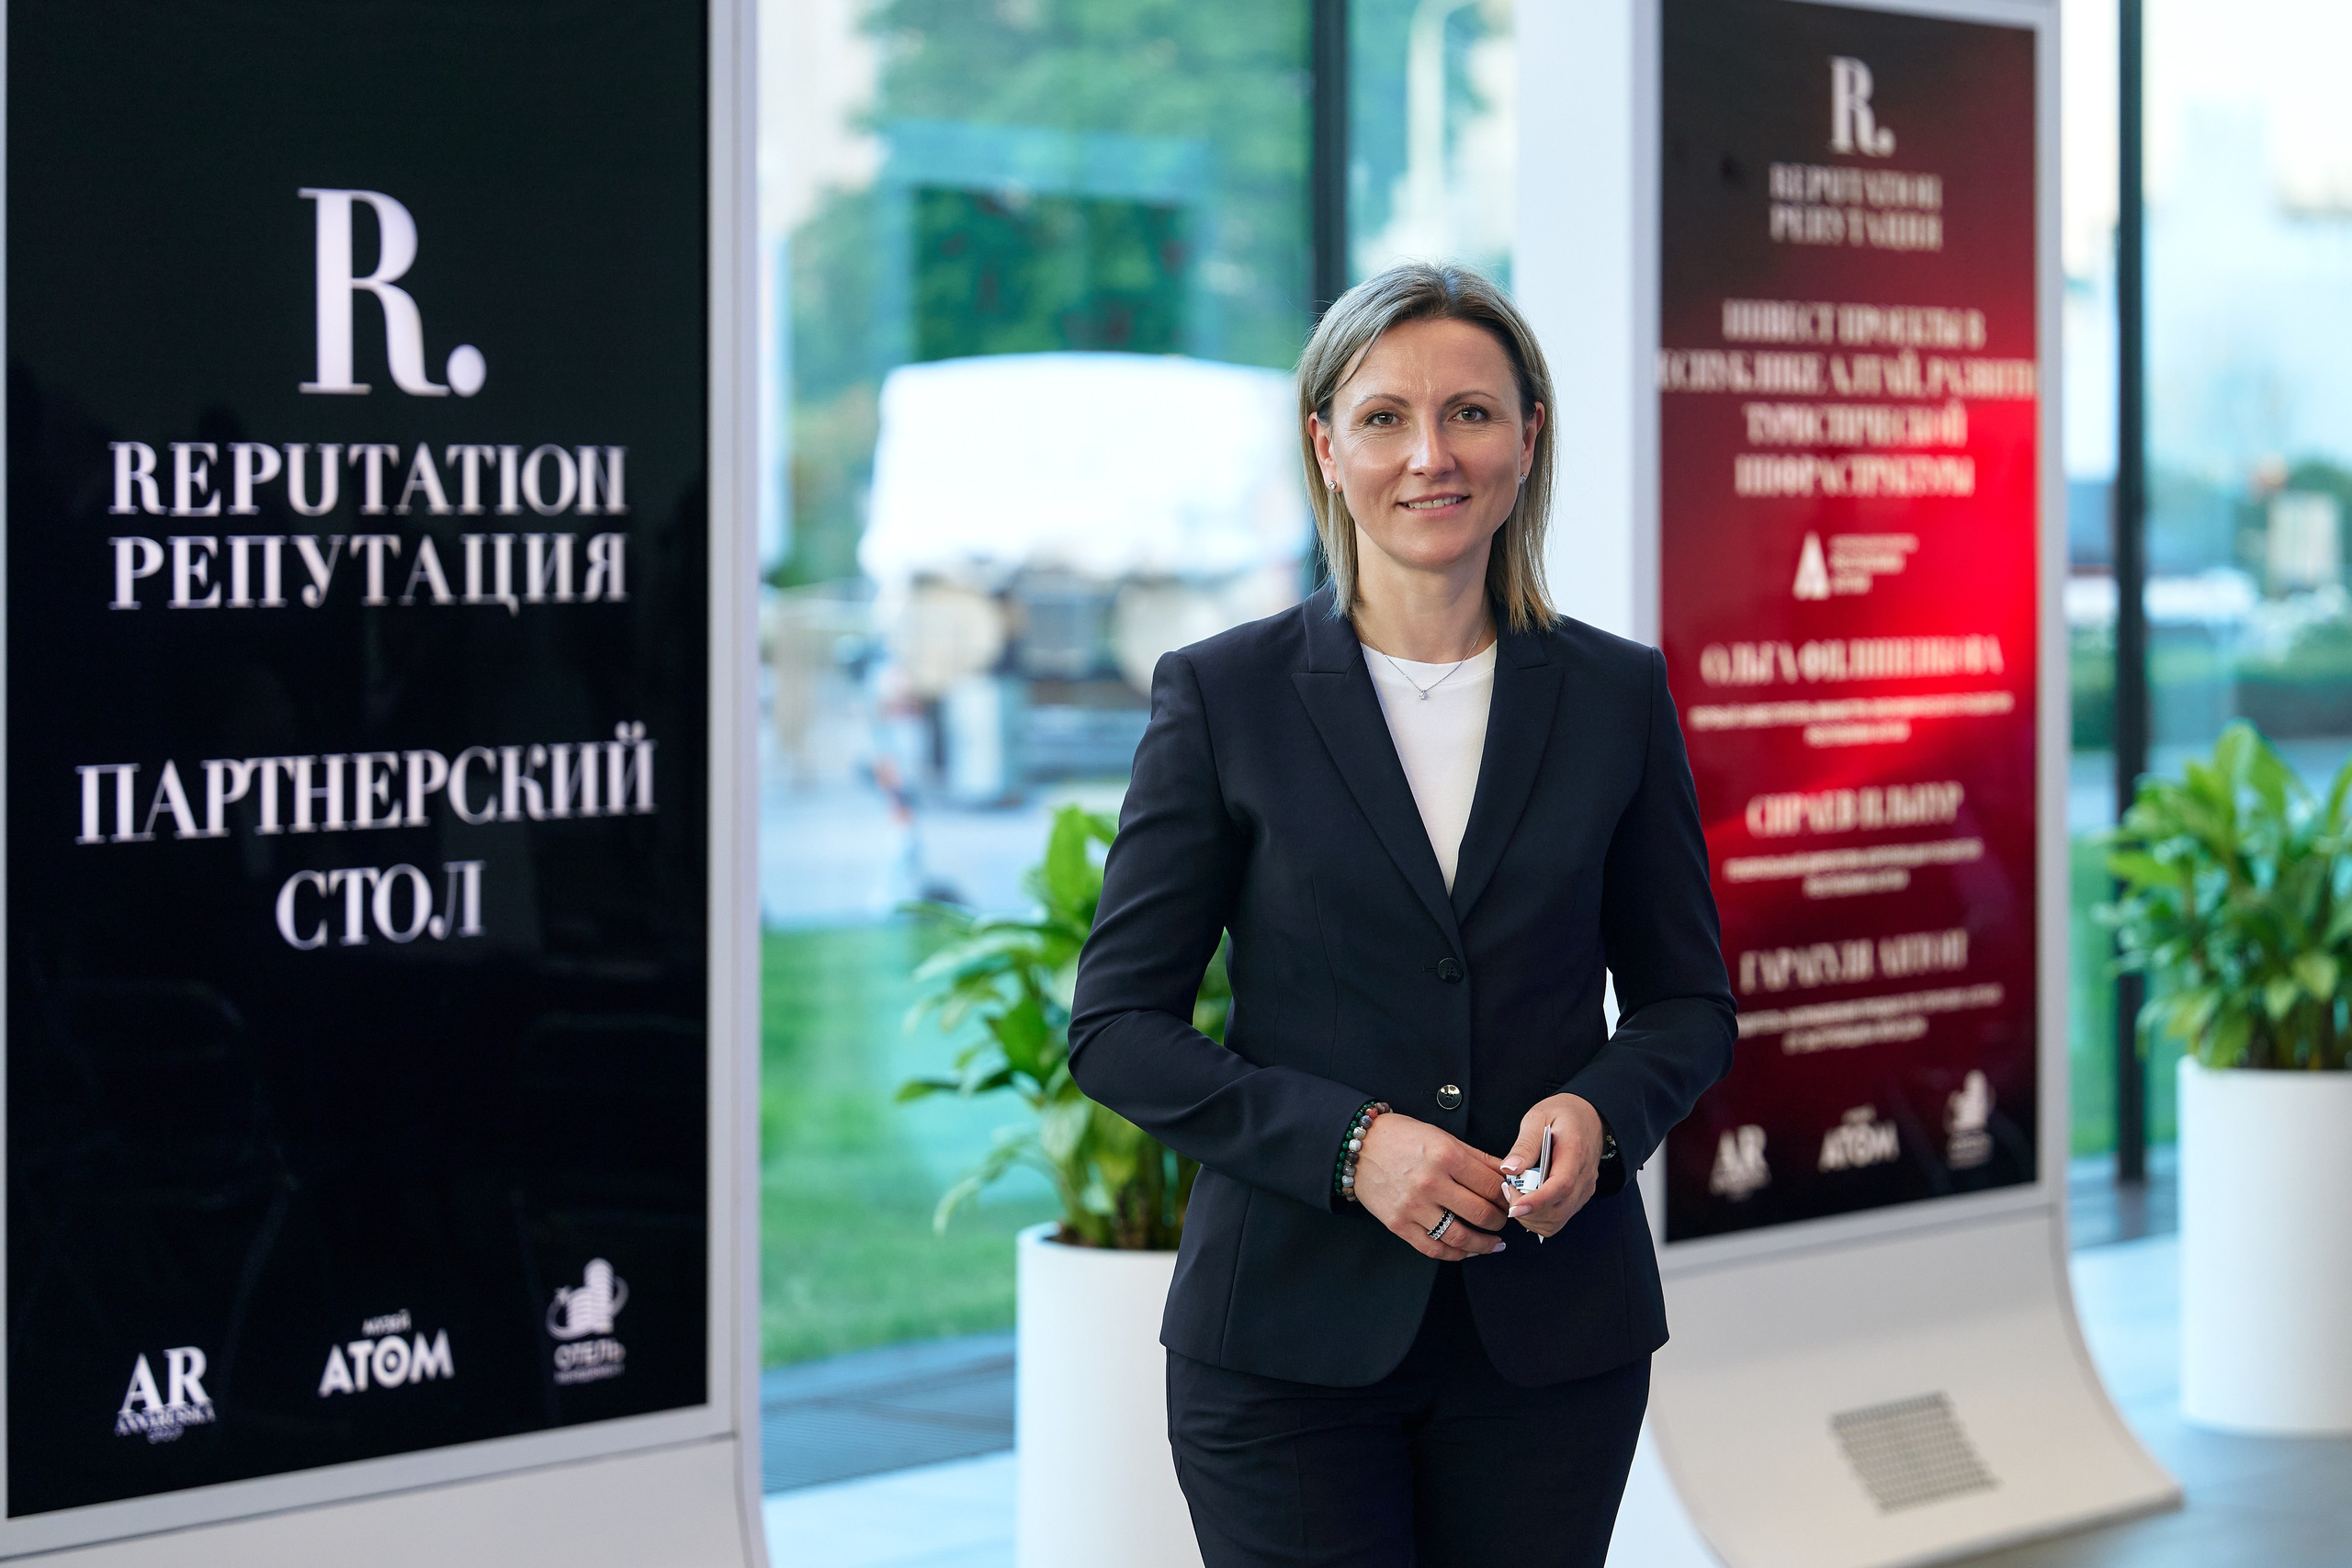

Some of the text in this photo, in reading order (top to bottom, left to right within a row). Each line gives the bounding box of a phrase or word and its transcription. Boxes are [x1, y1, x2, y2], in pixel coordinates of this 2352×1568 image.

[298, 186, 487, 398] R.
[108, 441, 631, 517] REPUTATION
[108, 532, 631, 615] РЕПУТАЦИЯ
[75, 720, 657, 844] ПАРТНЕРСКИЙ
[276, 860, 485, 951] СТОЛ
[121, 1346, 212, 1412] AR
